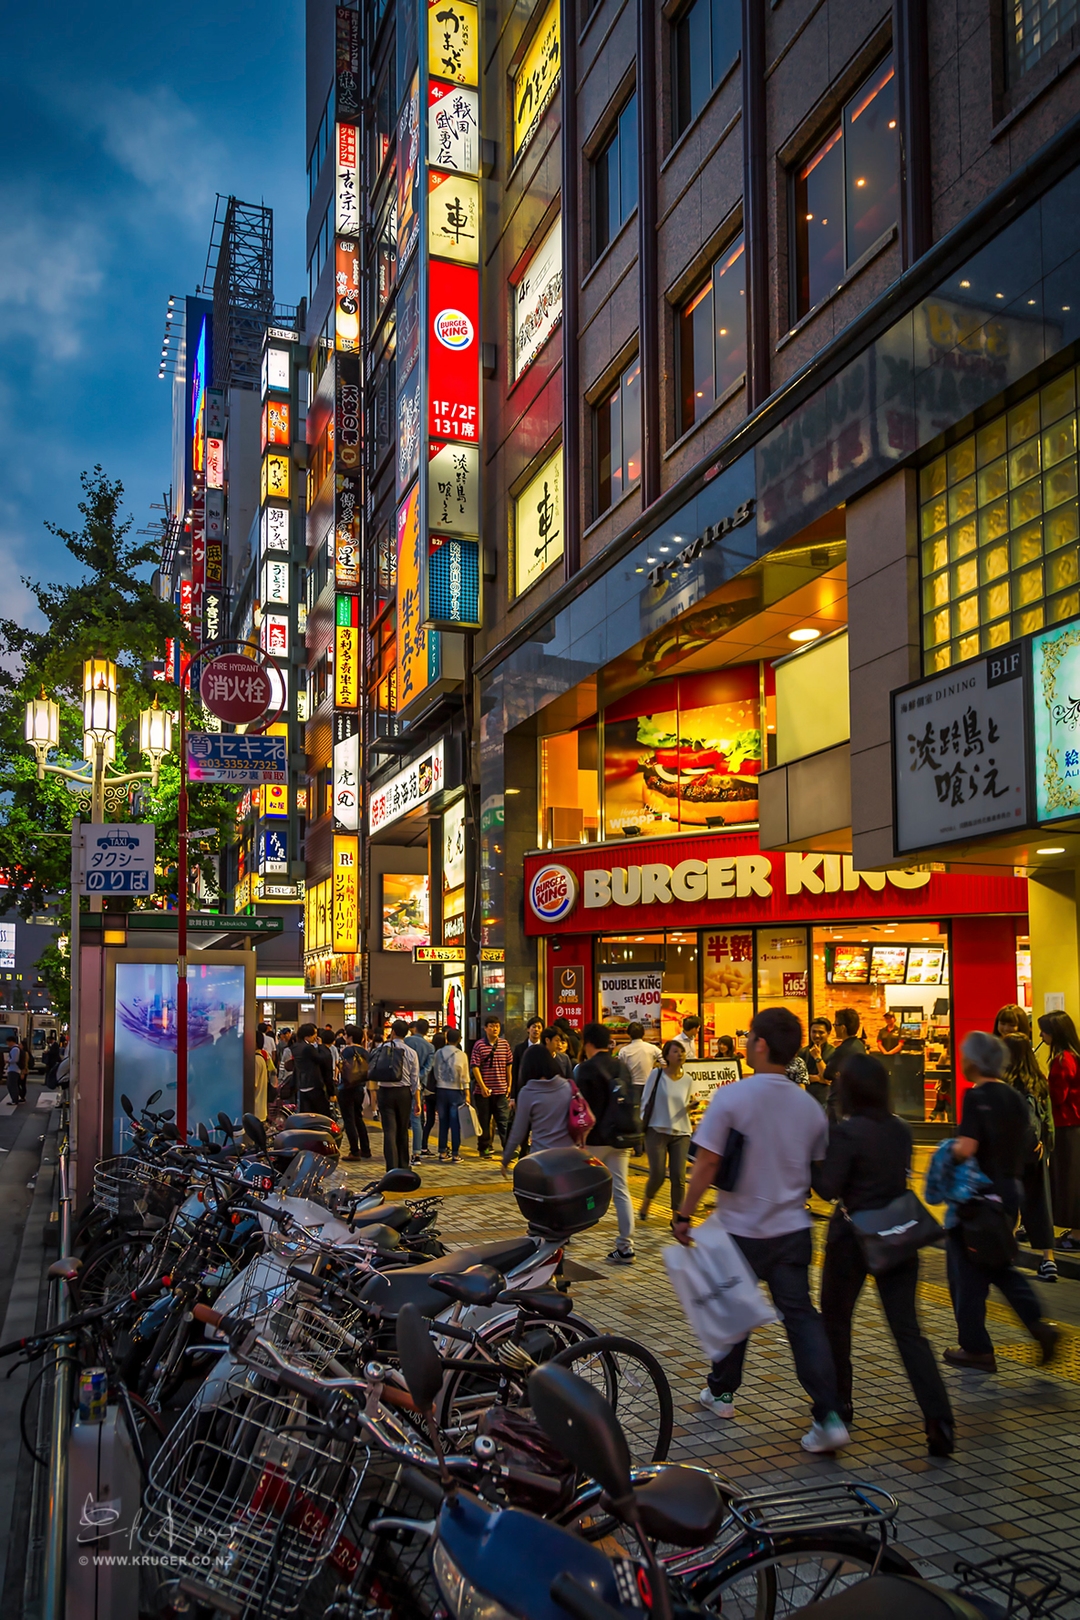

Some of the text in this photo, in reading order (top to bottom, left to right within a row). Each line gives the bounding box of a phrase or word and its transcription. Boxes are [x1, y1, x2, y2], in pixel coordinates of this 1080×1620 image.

[431, 86, 444, 99] 4F
[453, 96, 476, 134] 戦国
[436, 111, 458, 169] 武勇伝
[431, 174, 443, 186] 3F
[440, 318, 467, 329] BURGER
[441, 326, 468, 338] KING
[434, 419, 475, 437] 131席
[453, 454, 470, 514] 淡路島と
[647, 498, 757, 588] T-wing
[206, 544, 223, 581] 麻雀
[449, 541, 461, 621] 絵本の国のアリス
[212, 662, 260, 673] FIRE HYDRANT
[990, 652, 1020, 679] B1F
[208, 674, 267, 704] 消火栓
[935, 678, 976, 701] DINING
[189, 735, 286, 760] 質 セキネ
[907, 706, 1000, 771] 淡路島と
[207, 760, 278, 771] 03-3352-7325
[217, 770, 285, 781] アルタ裏 買取
[934, 759, 1010, 807] 喰らえ
[336, 769, 356, 807] 虎丸
[110, 838, 127, 846] TAXI
[91, 852, 145, 868] タクシー
[88, 871, 148, 890] のりば
[535, 875, 566, 893] BURGER
[584, 854, 773, 908] BURGER
[536, 884, 567, 907] KING
[335, 874, 345, 940] リンガーハット
[188, 919, 215, 927] 歌舞伎町
[707, 934, 752, 963] 半額
[602, 978, 661, 991] DOUBLE KING
[784, 979, 806, 991] ¥165
[634, 990, 661, 1005] ¥490
[565, 1007, 582, 1015] 118席
[717, 1069, 736, 1080] KING
